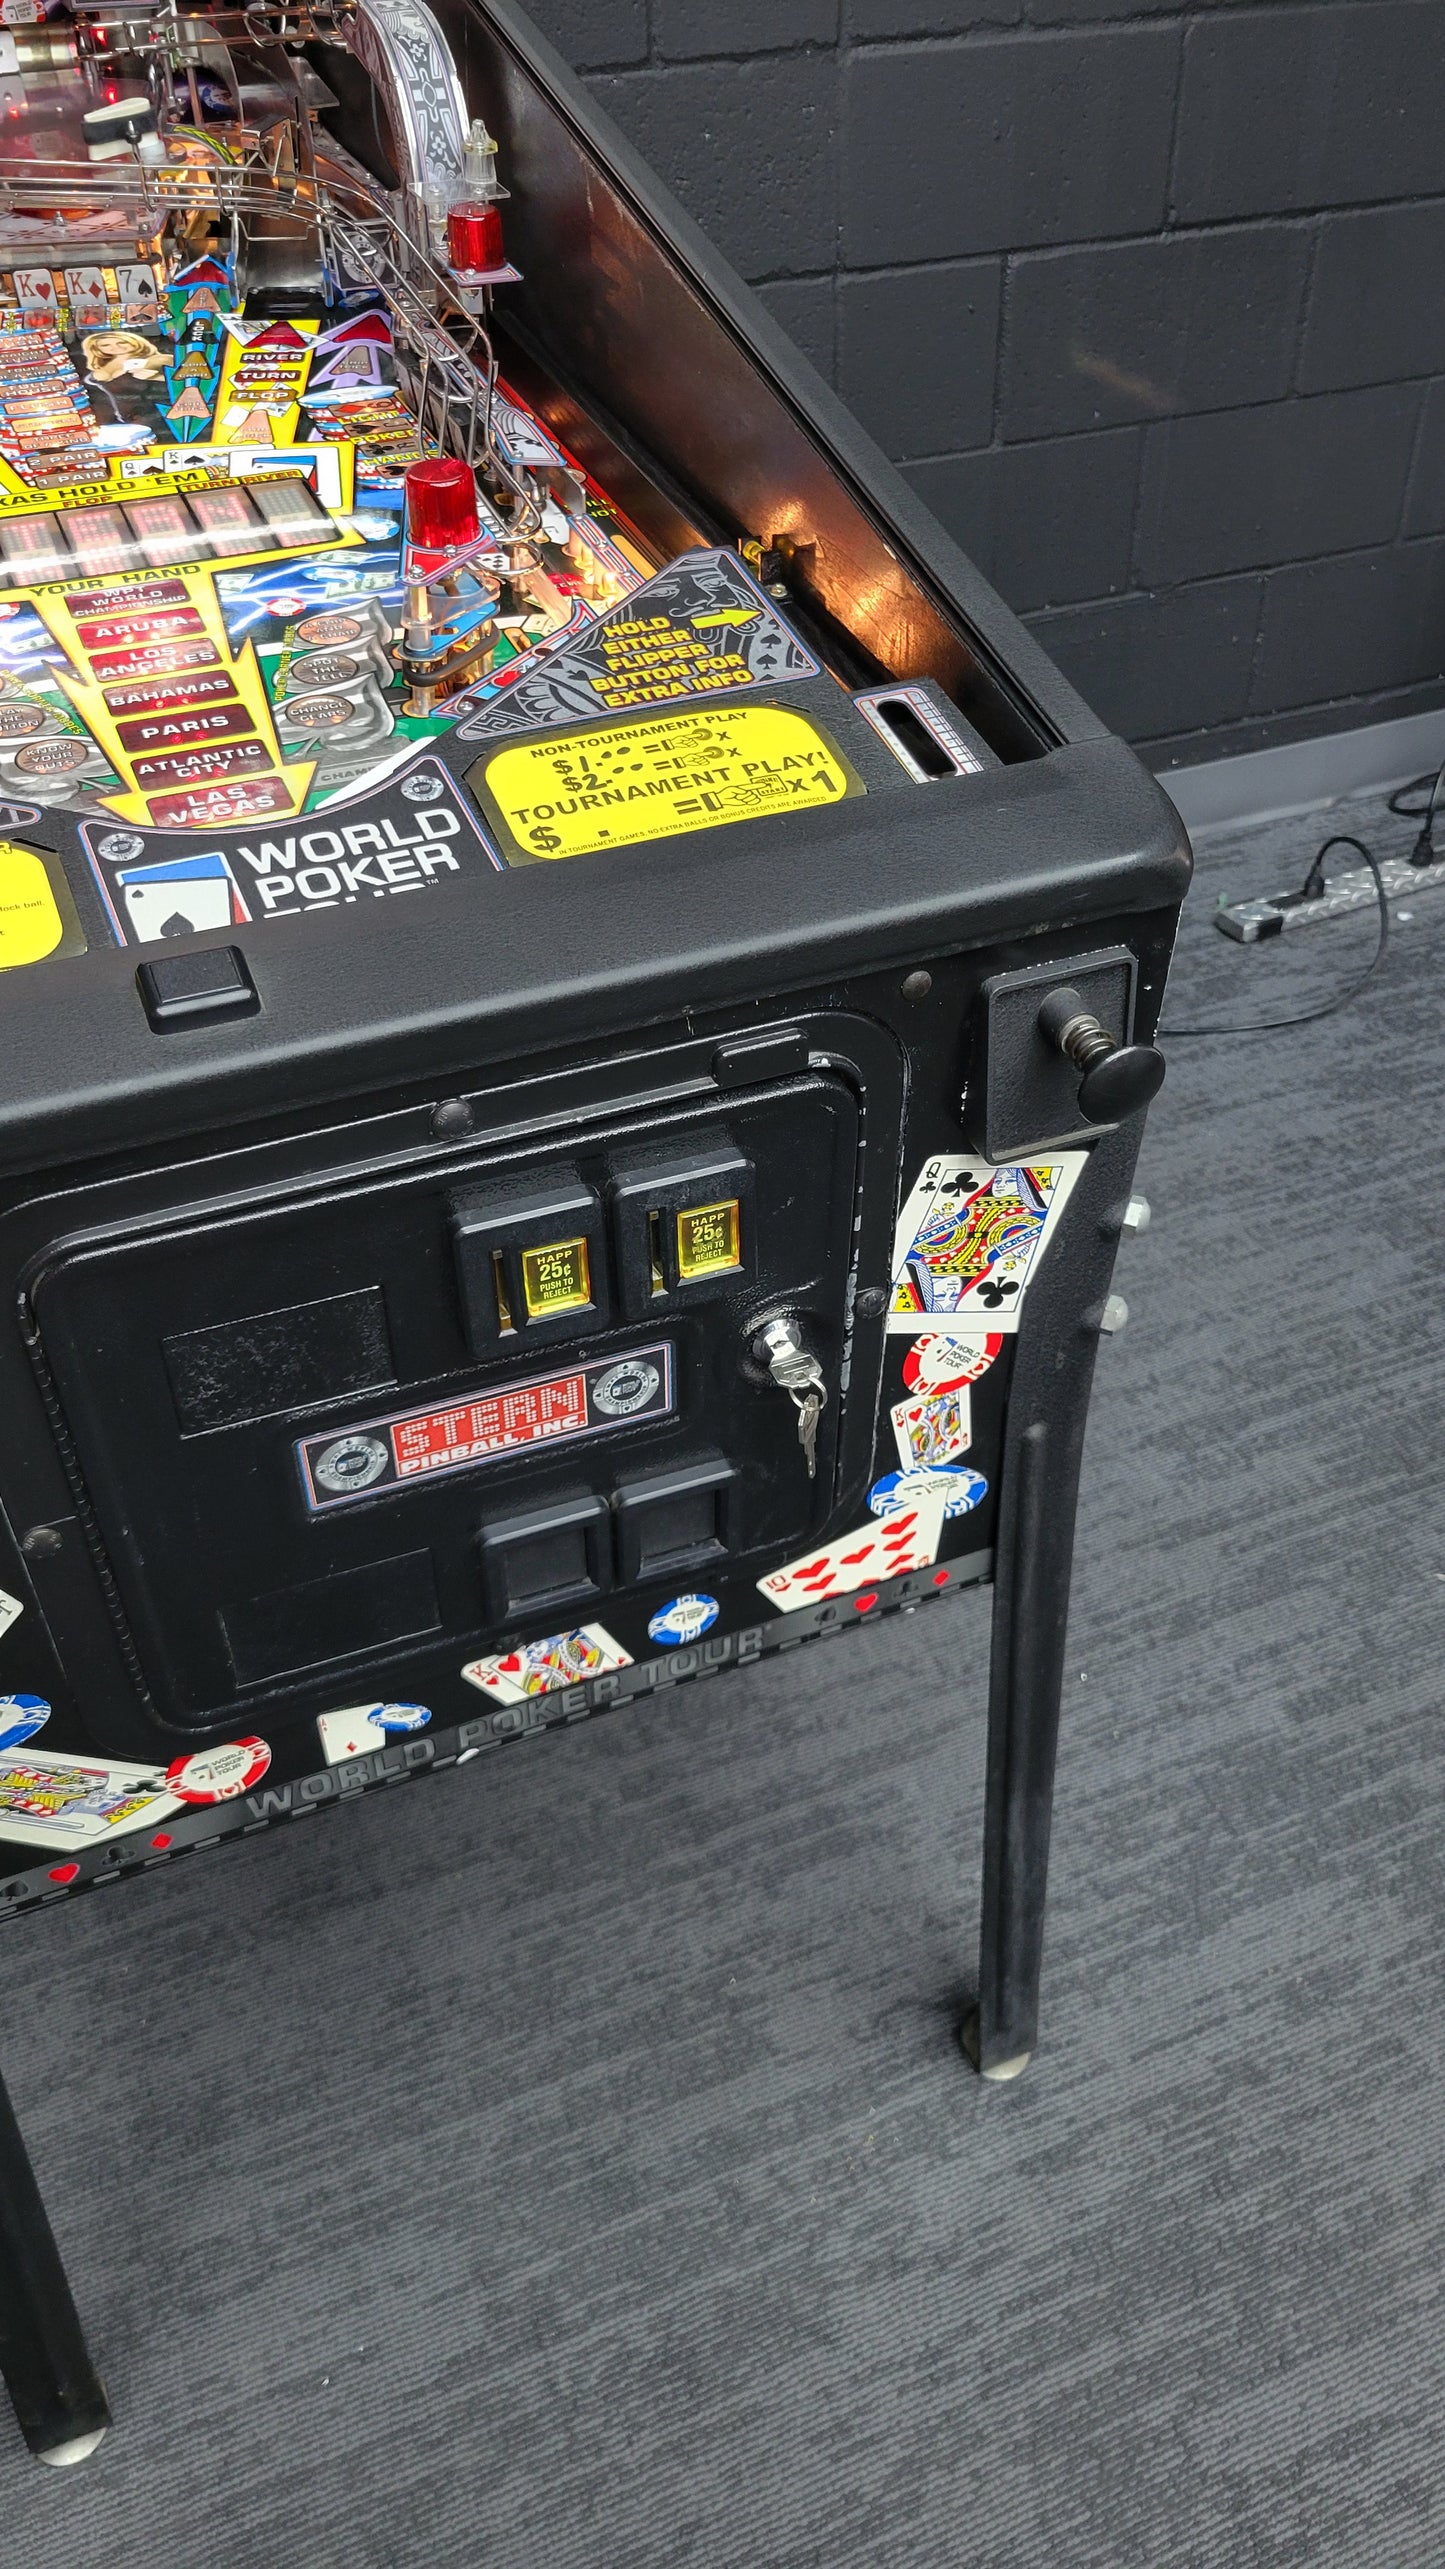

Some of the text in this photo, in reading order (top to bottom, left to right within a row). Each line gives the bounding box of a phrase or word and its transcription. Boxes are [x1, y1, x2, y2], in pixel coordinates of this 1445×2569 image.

[17, 274, 36, 297] K
[68, 272, 87, 295] K
[119, 269, 132, 293] 7
[242, 353, 303, 361] RIVER
[236, 391, 289, 399] FLOP
[50, 452, 96, 463] PAIR
[58, 471, 105, 482] PAIR
[184, 478, 235, 492] TURN
[241, 469, 301, 485] RIVER
[58, 481, 136, 498] HOLD
[63, 495, 113, 508] FLOP
[30, 579, 104, 597] YOUR
[122, 565, 201, 583] HAND
[91, 590, 163, 606] WORLD
[103, 585, 144, 598] WPT
[95, 616, 189, 638] ARUBA
[602, 616, 671, 639] HOLD
[602, 629, 693, 655] EITHER
[129, 646, 177, 661] LOS
[605, 642, 711, 672] FLIPPER
[100, 651, 215, 677] ANGELES
[590, 653, 746, 692] BUTTON FOR
[110, 680, 230, 706] BAHAMAS
[602, 669, 754, 708] EXTRA INFO
[141, 715, 229, 739] PARIS
[530, 712, 748, 758] NON-TOURNAMENT PLAY
[27, 743, 73, 756] KNOW
[32, 751, 73, 762] YOUR
[138, 745, 261, 775] ATLANTIC
[176, 760, 232, 778] CITY
[186, 787, 247, 807] LAS
[510, 751, 829, 825] TOURNAMENT PLAY!
[167, 796, 275, 824] VEGAS
[569, 836, 617, 852] TOURNAMENT
[660, 823, 683, 832] EXTRA
[685, 818, 708, 827] BALLS
[721, 809, 746, 819] BONUS
[746, 804, 776, 813] CREDITS
[793, 796, 827, 806] AWARDED
[236, 808, 461, 874] WORLD
[255, 843, 460, 909] POKER
[926, 1162, 941, 1178] Q
[690, 1213, 725, 1227] HAPP
[693, 1223, 723, 1244] 25¢
[692, 1239, 725, 1255] PUSH TO
[695, 1249, 722, 1262] REJECT
[537, 1250, 573, 1266] HAPP
[540, 1261, 571, 1281] 25¢
[540, 1277, 574, 1292] PUSH TO
[543, 1286, 572, 1299] REJECT
[949, 1350, 972, 1363] POKER
[957, 1344, 980, 1358] WORLD
[944, 1357, 963, 1369] TOUR
[400, 1380, 579, 1458] STERN
[400, 1429, 525, 1474] PINBALL,
[532, 1416, 586, 1437] INC.
[246, 1629, 765, 1818] WORLD POKER TOUR
[211, 1749, 246, 1766] WORLD
[214, 1756, 245, 1771] POKER
[217, 1763, 242, 1775] TOUR
